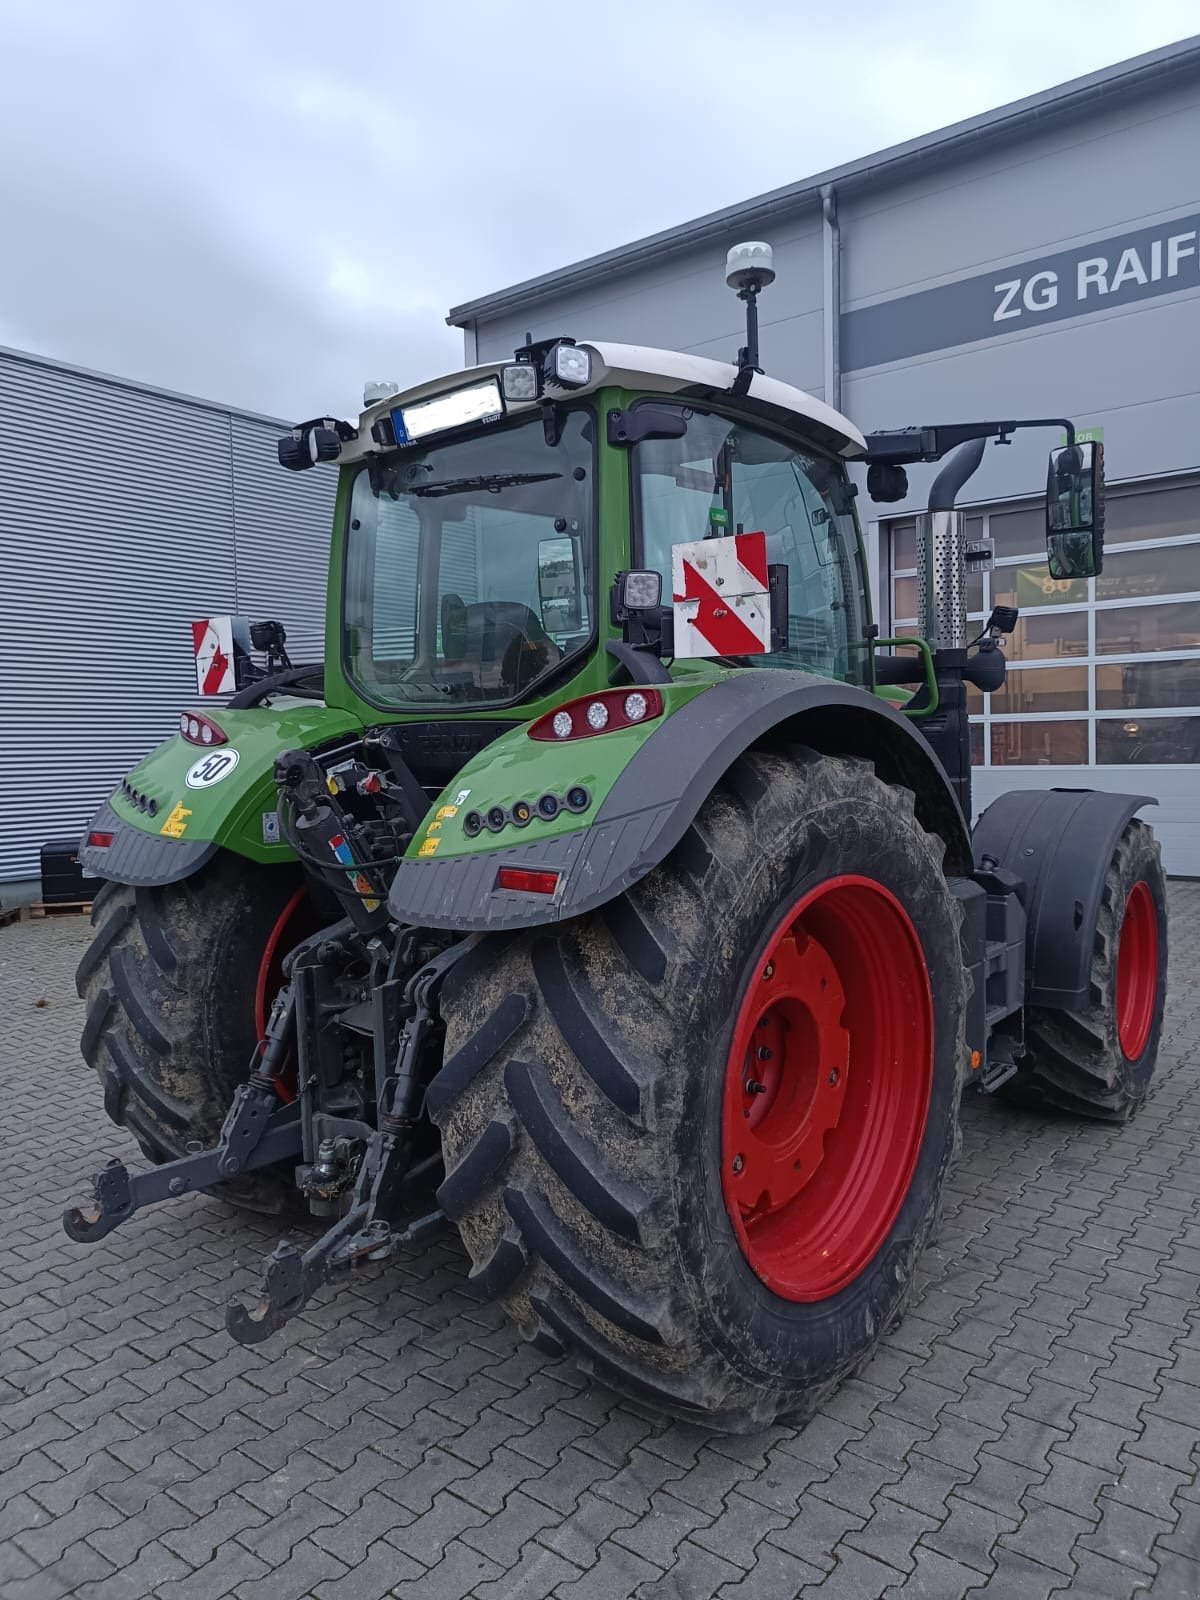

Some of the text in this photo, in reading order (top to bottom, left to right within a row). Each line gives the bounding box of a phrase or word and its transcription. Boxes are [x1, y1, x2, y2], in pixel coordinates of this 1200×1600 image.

[993, 231, 1200, 322] ZG RAIF
[193, 754, 231, 781] 50
